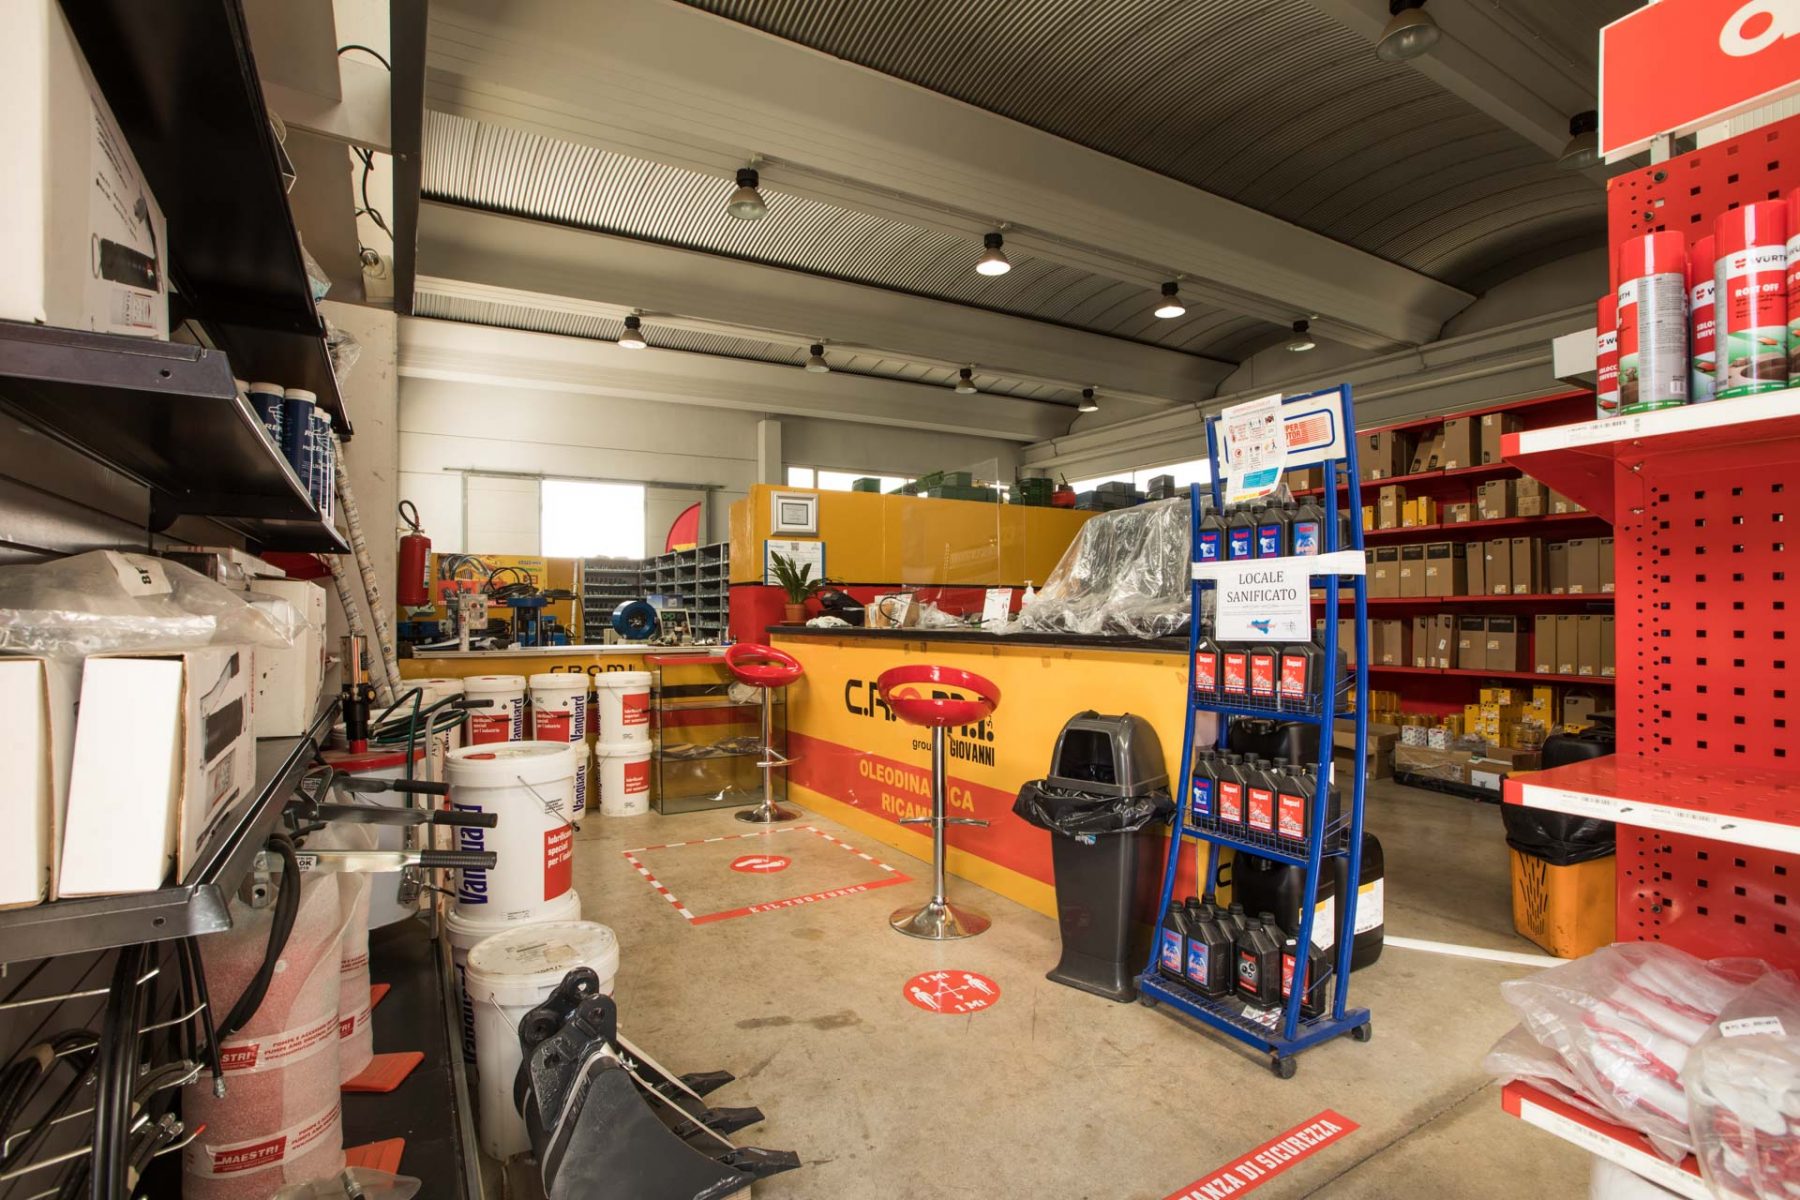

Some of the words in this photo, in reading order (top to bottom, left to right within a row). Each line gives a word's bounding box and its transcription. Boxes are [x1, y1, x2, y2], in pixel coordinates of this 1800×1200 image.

[1763, 282, 1779, 292] OFF
[1239, 571, 1284, 585] LOCALE
[1227, 588, 1297, 603] SANIFICATO
[510, 697, 523, 742] anguard
[570, 695, 585, 742] Vanguard
[912, 739, 932, 751] grou
[950, 740, 995, 767] GIOVANNI
[859, 759, 975, 812] OLEODINACA
[782, 896, 814, 906] TUO
[816, 885, 867, 900] TURNO
[221, 1052, 252, 1064] STRI
[221, 1145, 280, 1166] MAESTRI
[1234, 1160, 1266, 1181] DI
[1255, 1119, 1343, 1170] SICUREZZA
